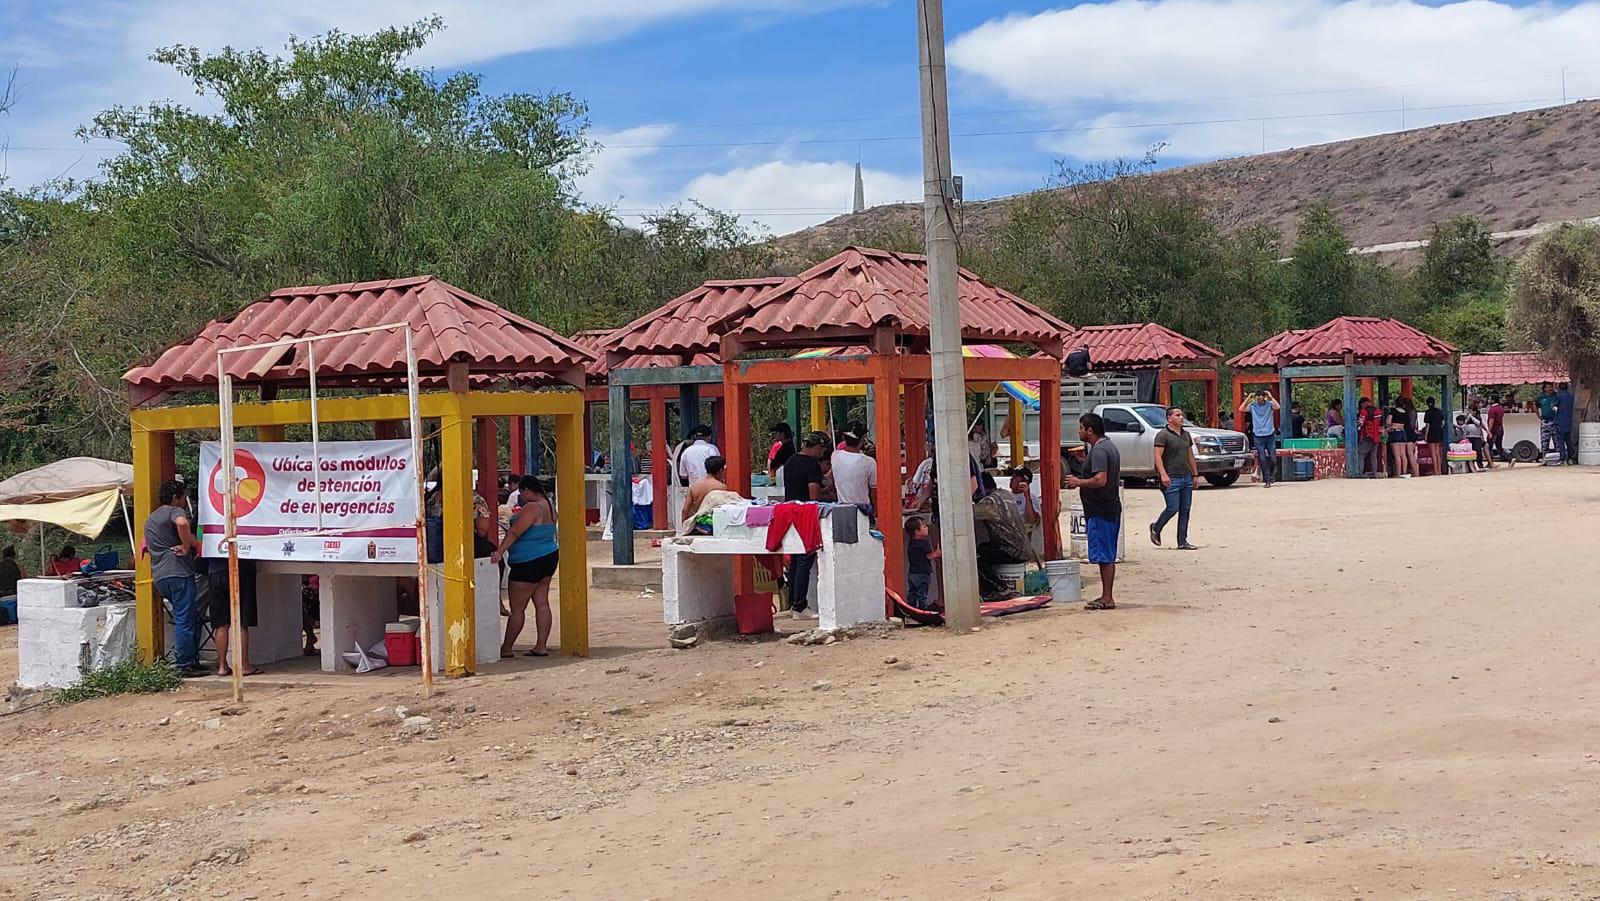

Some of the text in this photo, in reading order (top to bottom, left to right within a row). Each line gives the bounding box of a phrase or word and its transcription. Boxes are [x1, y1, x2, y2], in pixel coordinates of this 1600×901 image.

[272, 455, 313, 472] Ubica
[340, 455, 406, 472] módulos
[297, 475, 381, 493] de atención
[280, 499, 299, 514] de
